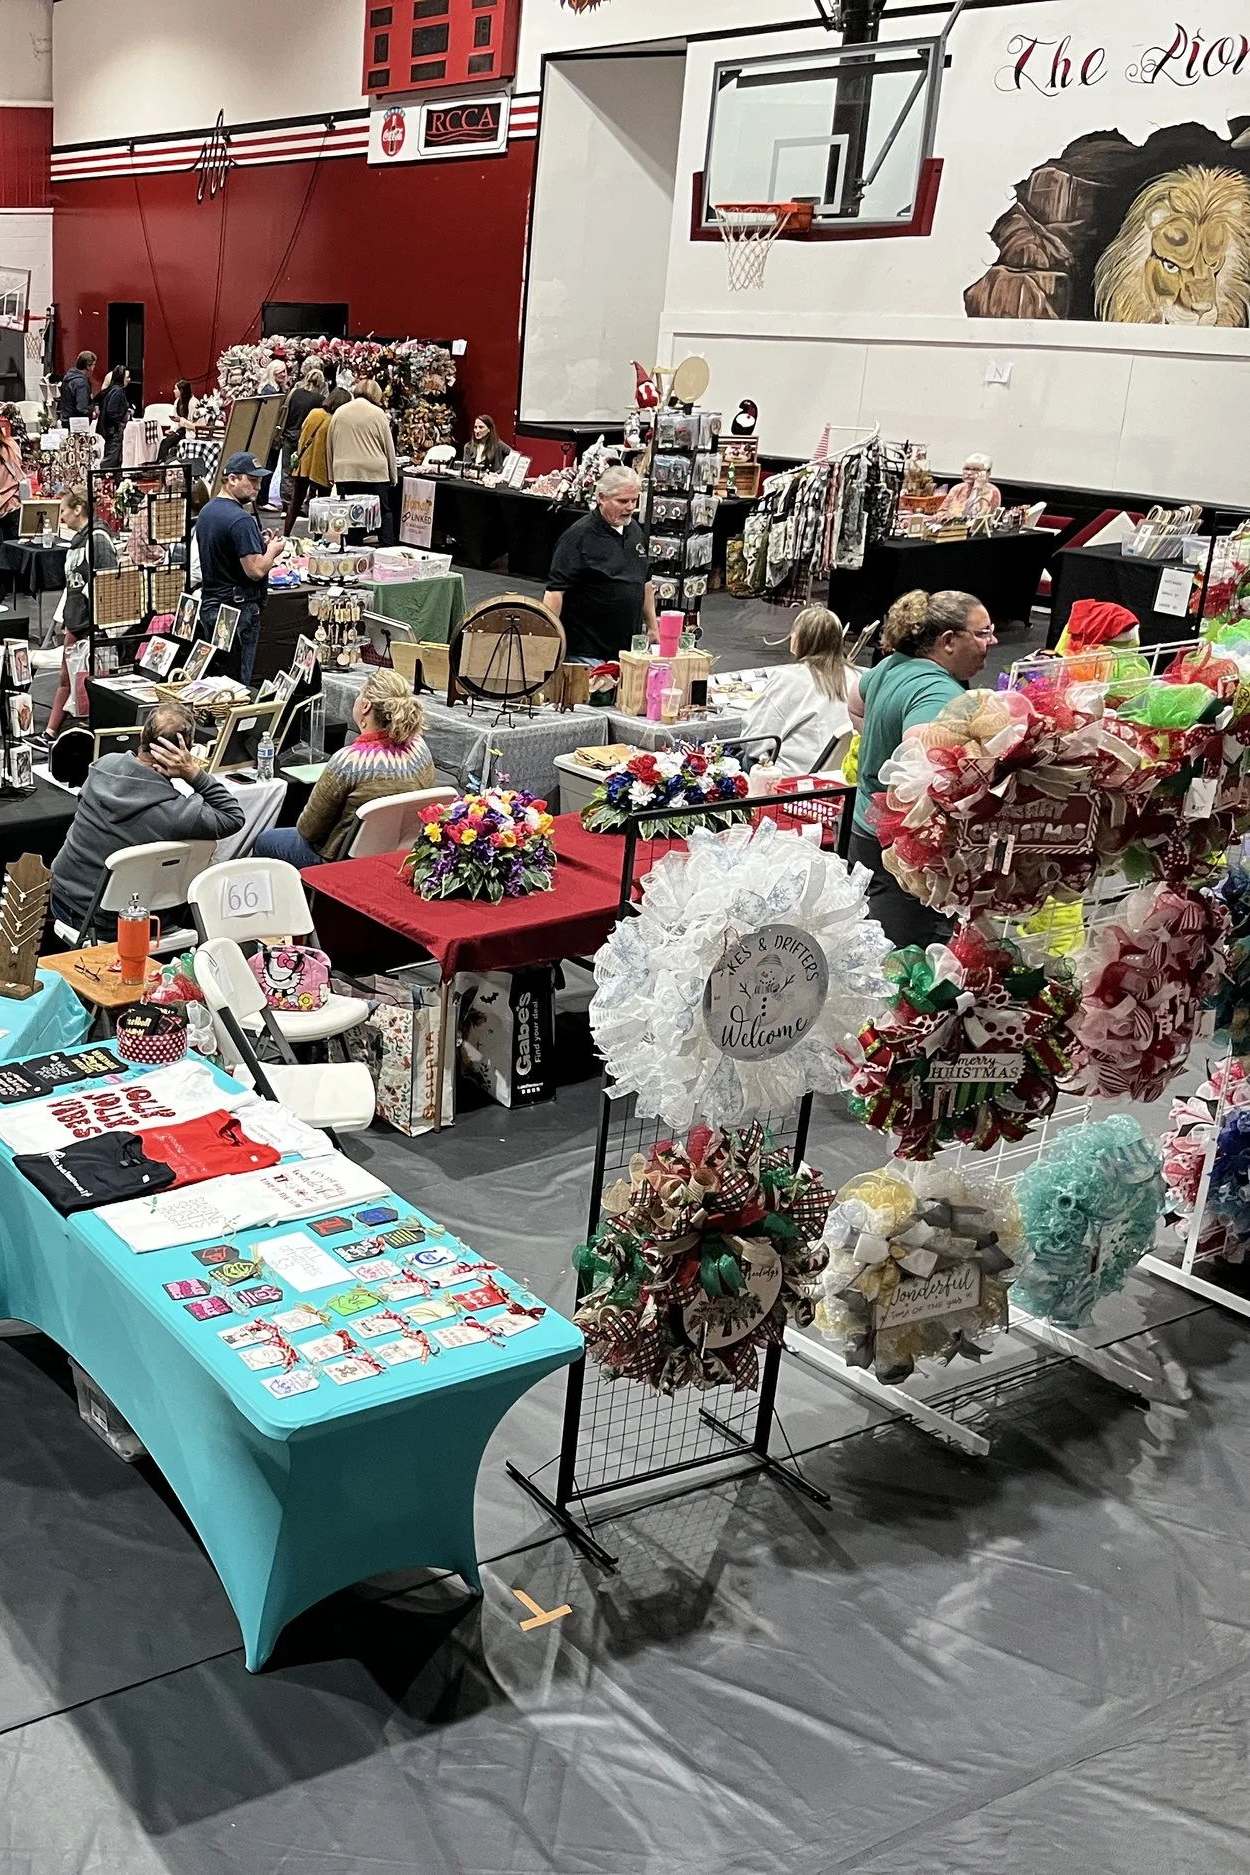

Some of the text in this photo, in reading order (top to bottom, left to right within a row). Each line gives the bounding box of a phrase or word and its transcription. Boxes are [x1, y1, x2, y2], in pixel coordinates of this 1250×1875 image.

[995, 34, 1108, 97] The
[431, 106, 498, 134] RCCA
[970, 821, 1087, 841] CHRISTMAS
[228, 882, 258, 910] 66
[773, 935, 819, 982] DRIFTERS
[515, 991, 532, 1076] Gabe's
[533, 1022, 541, 1041] your
[721, 1005, 808, 1049] Welcome
[425, 1031, 435, 1101] SIERRA
[534, 1044, 542, 1063] Find
[957, 1056, 996, 1069] merry
[932, 1066, 1019, 1079] HRISTMAS
[47, 1099, 102, 1138] VIBES
[82, 1093, 139, 1128] JOLLY
[121, 1086, 176, 1118] JOLLY
[891, 1268, 975, 1306] onderful
